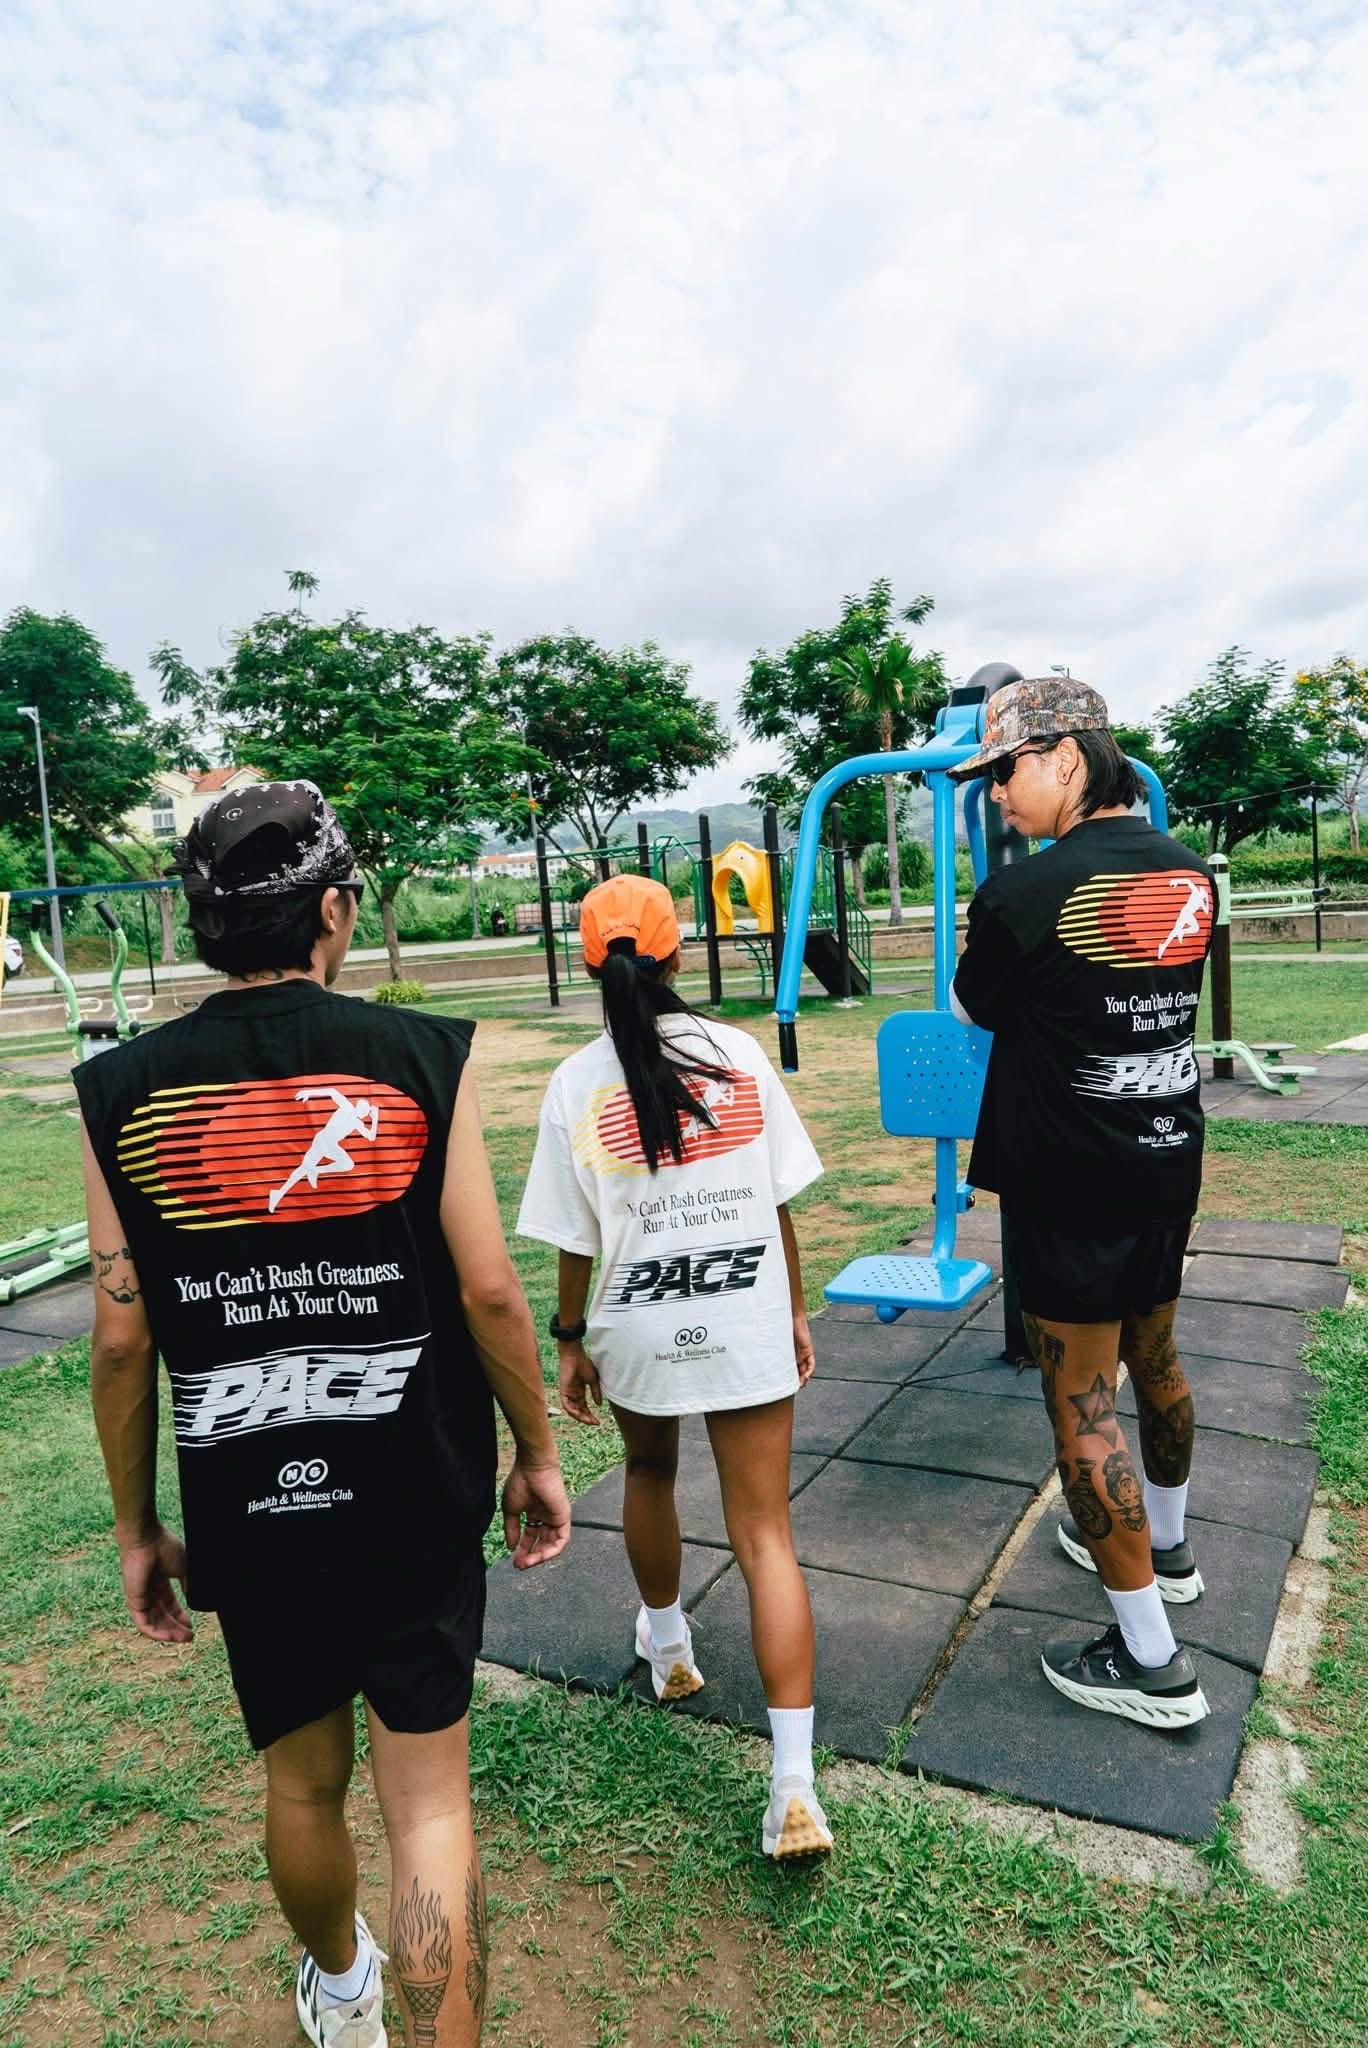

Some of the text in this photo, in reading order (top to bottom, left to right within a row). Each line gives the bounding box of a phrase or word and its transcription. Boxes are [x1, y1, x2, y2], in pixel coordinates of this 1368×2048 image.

[1104, 996, 1127, 1014] You
[1132, 1015, 1155, 1032] Run
[1107, 1041, 1198, 1094] PAC
[639, 1196, 667, 1218] Can't
[697, 1186, 757, 1206] Greatness.
[643, 1219, 665, 1235] Run
[681, 1211, 709, 1228] Your
[711, 1206, 739, 1224] Own
[174, 1260, 405, 1303] You Can't Rush Greatness.
[616, 1244, 767, 1304] PACE
[223, 1290, 379, 1326] Run At Your Own
[187, 1347, 423, 1437] PACE
[247, 1489, 354, 1514] Health & Wellness Club
